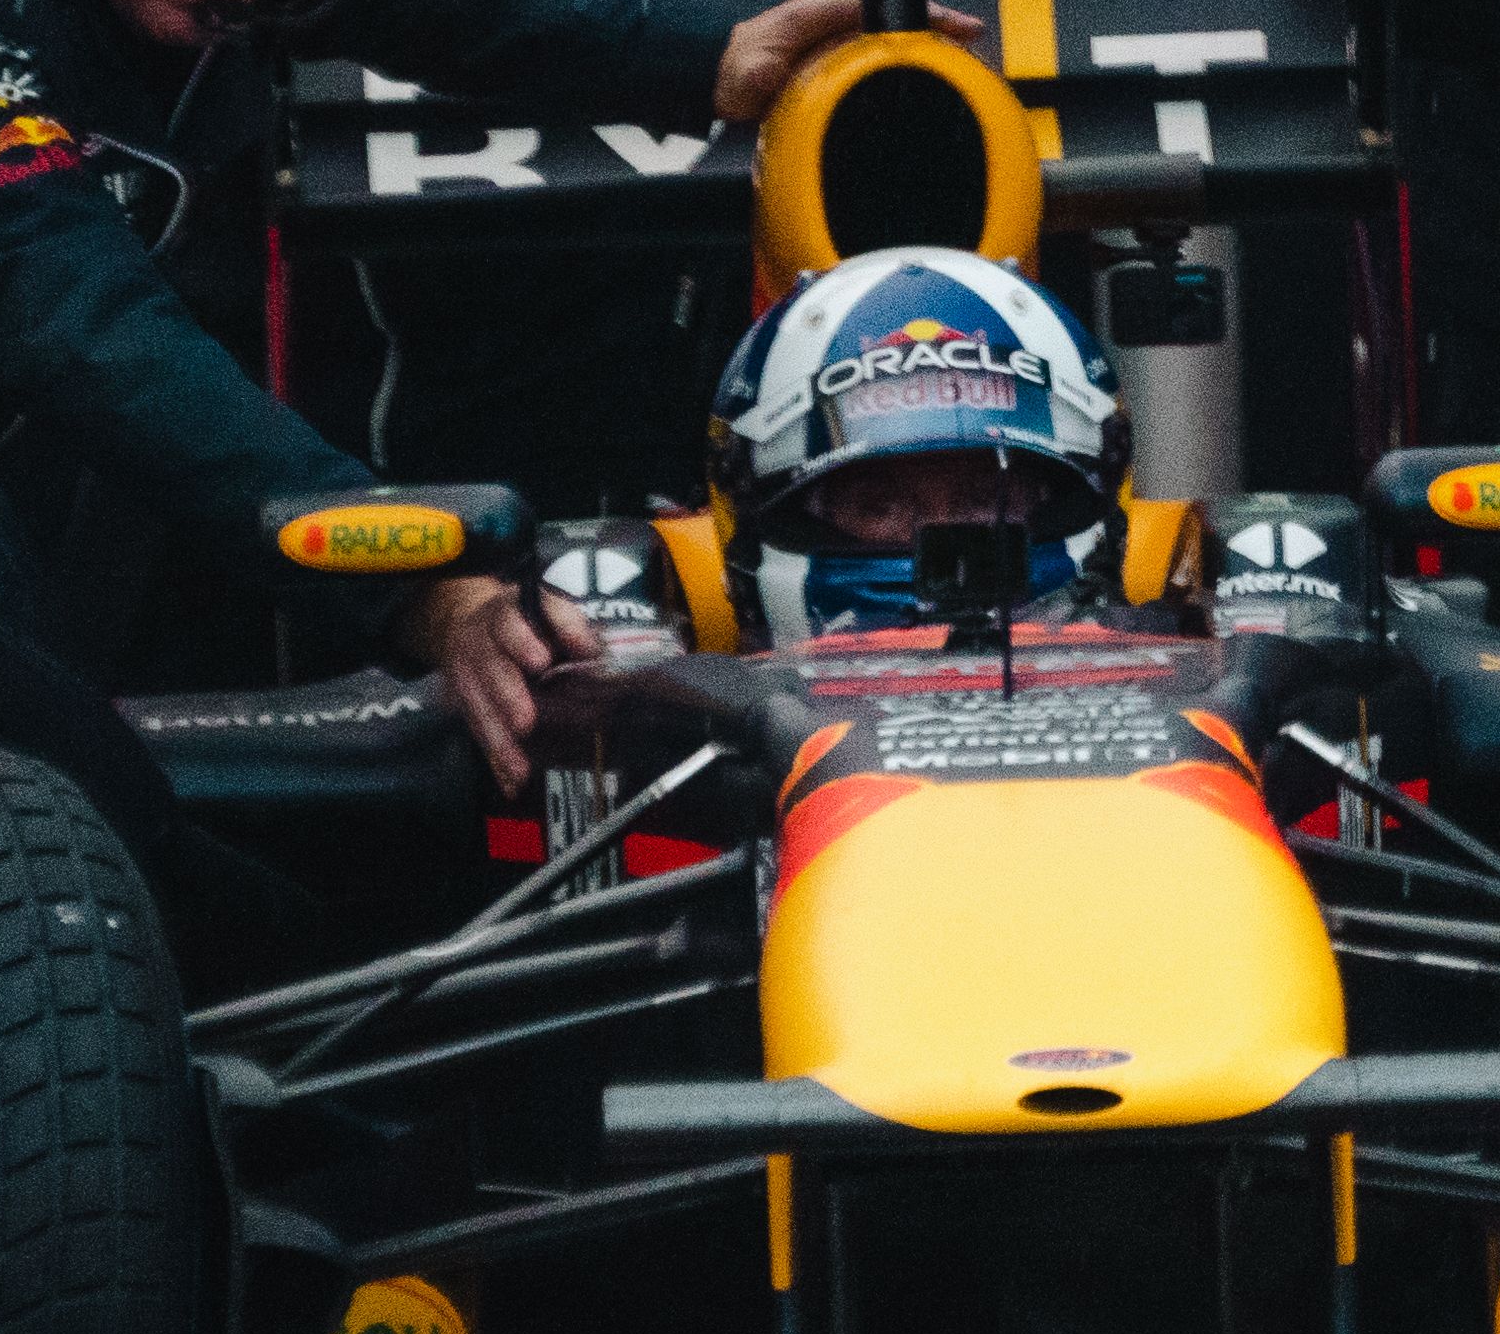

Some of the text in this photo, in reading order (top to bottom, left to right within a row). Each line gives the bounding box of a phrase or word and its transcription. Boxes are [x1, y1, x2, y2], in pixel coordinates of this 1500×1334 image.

[817, 341, 1046, 396] ORACLE
[330, 523, 446, 556] RAUCH
[1215, 571, 1342, 603] inter.mx
